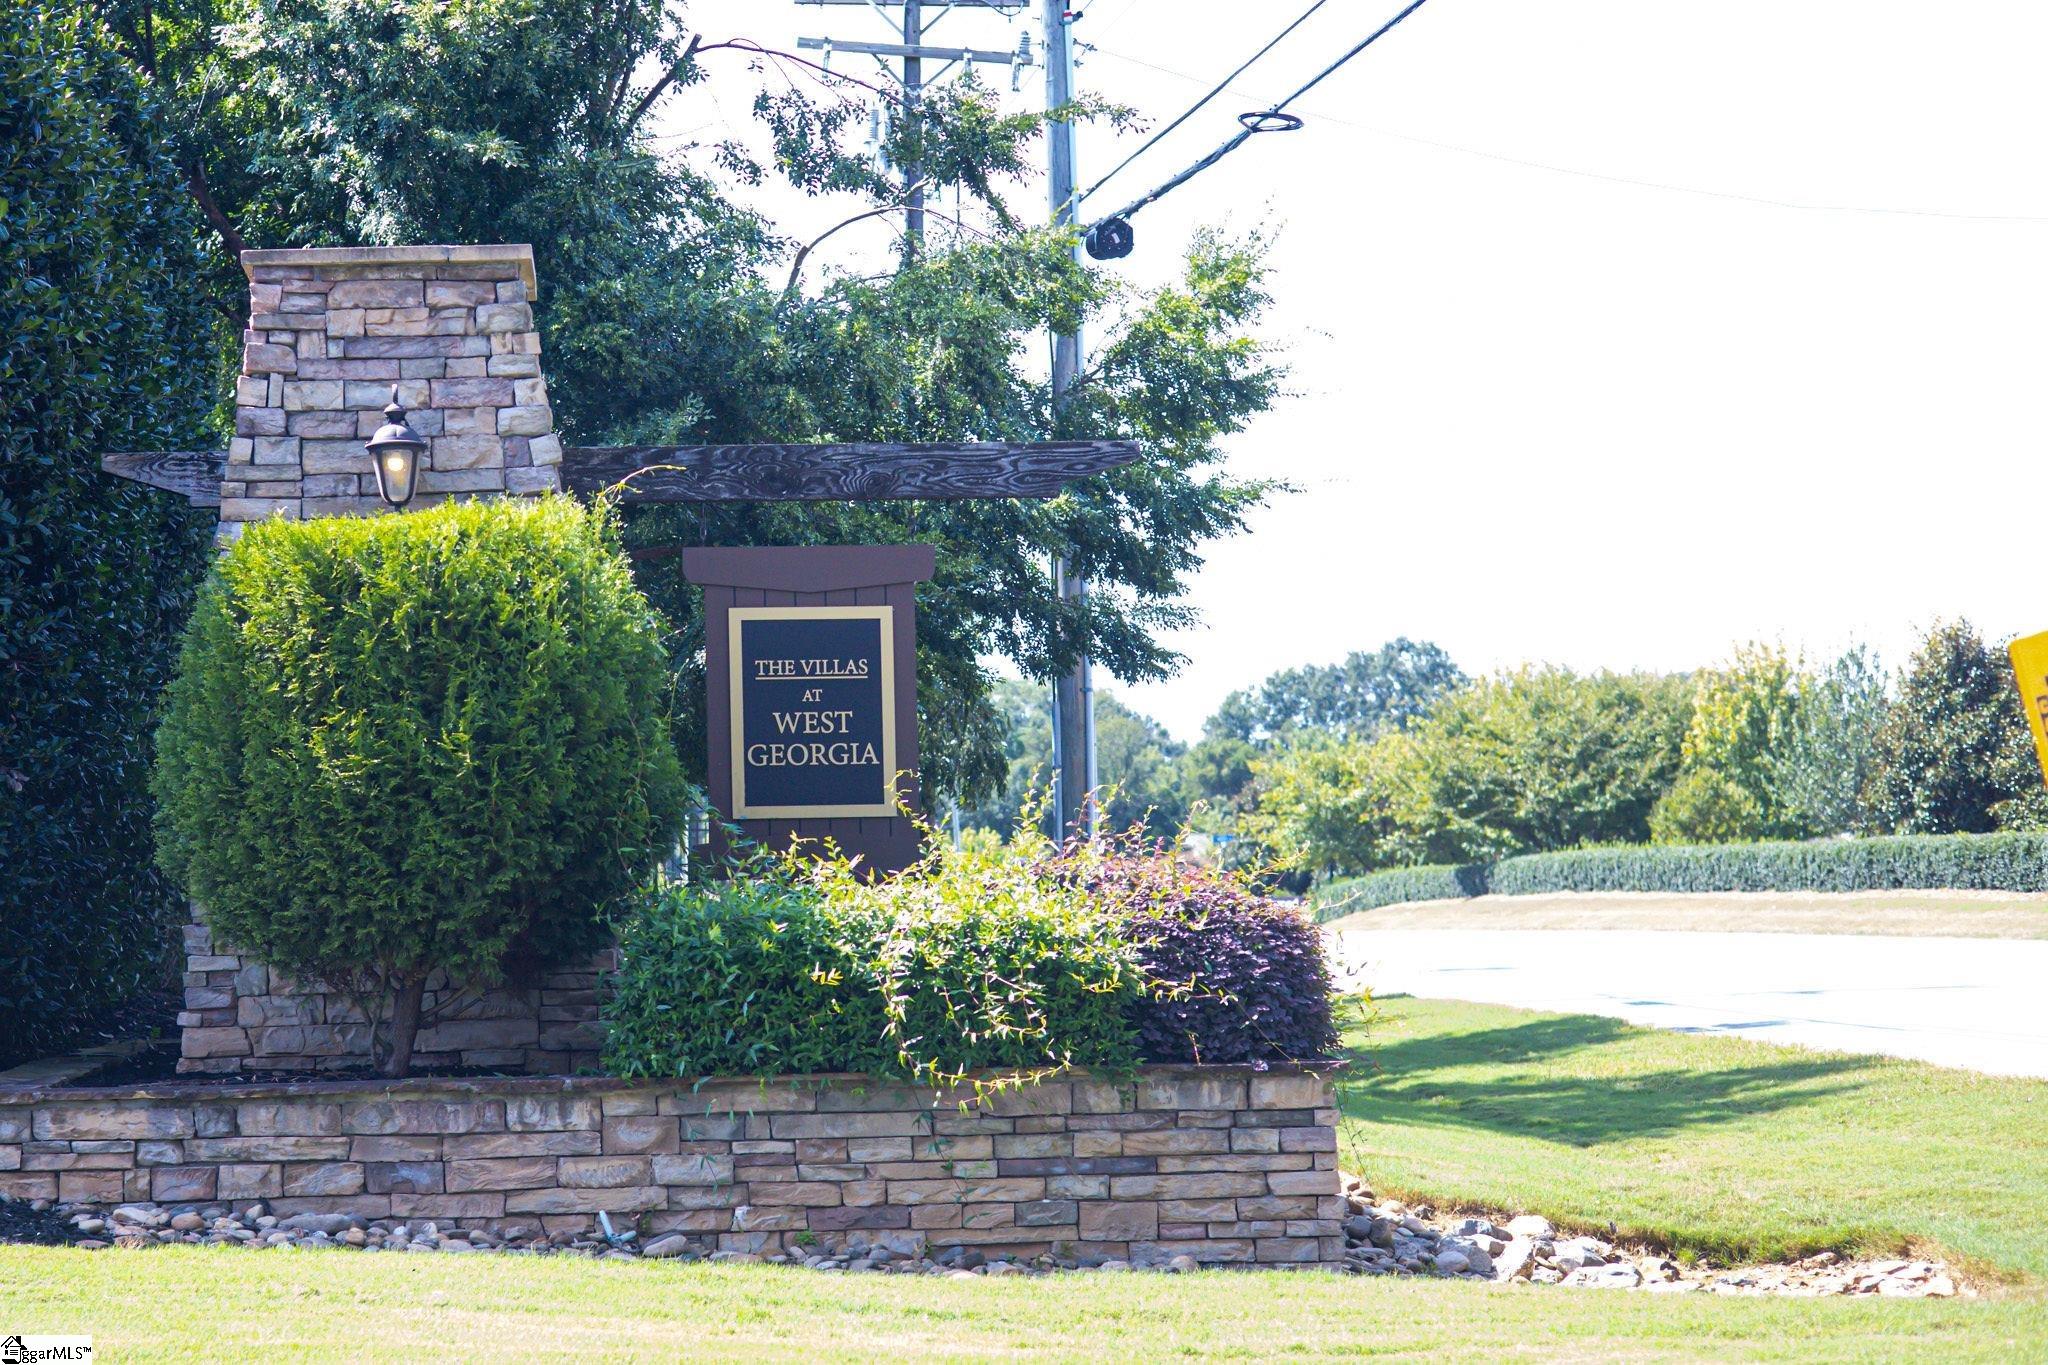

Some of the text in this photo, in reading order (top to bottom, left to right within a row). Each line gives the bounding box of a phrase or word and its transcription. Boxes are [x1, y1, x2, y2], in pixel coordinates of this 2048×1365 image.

[755, 658, 868, 676] THE VILLAS
[802, 689, 823, 702] AT
[772, 711, 853, 734] WEST
[747, 743, 880, 767] GEORGIA
